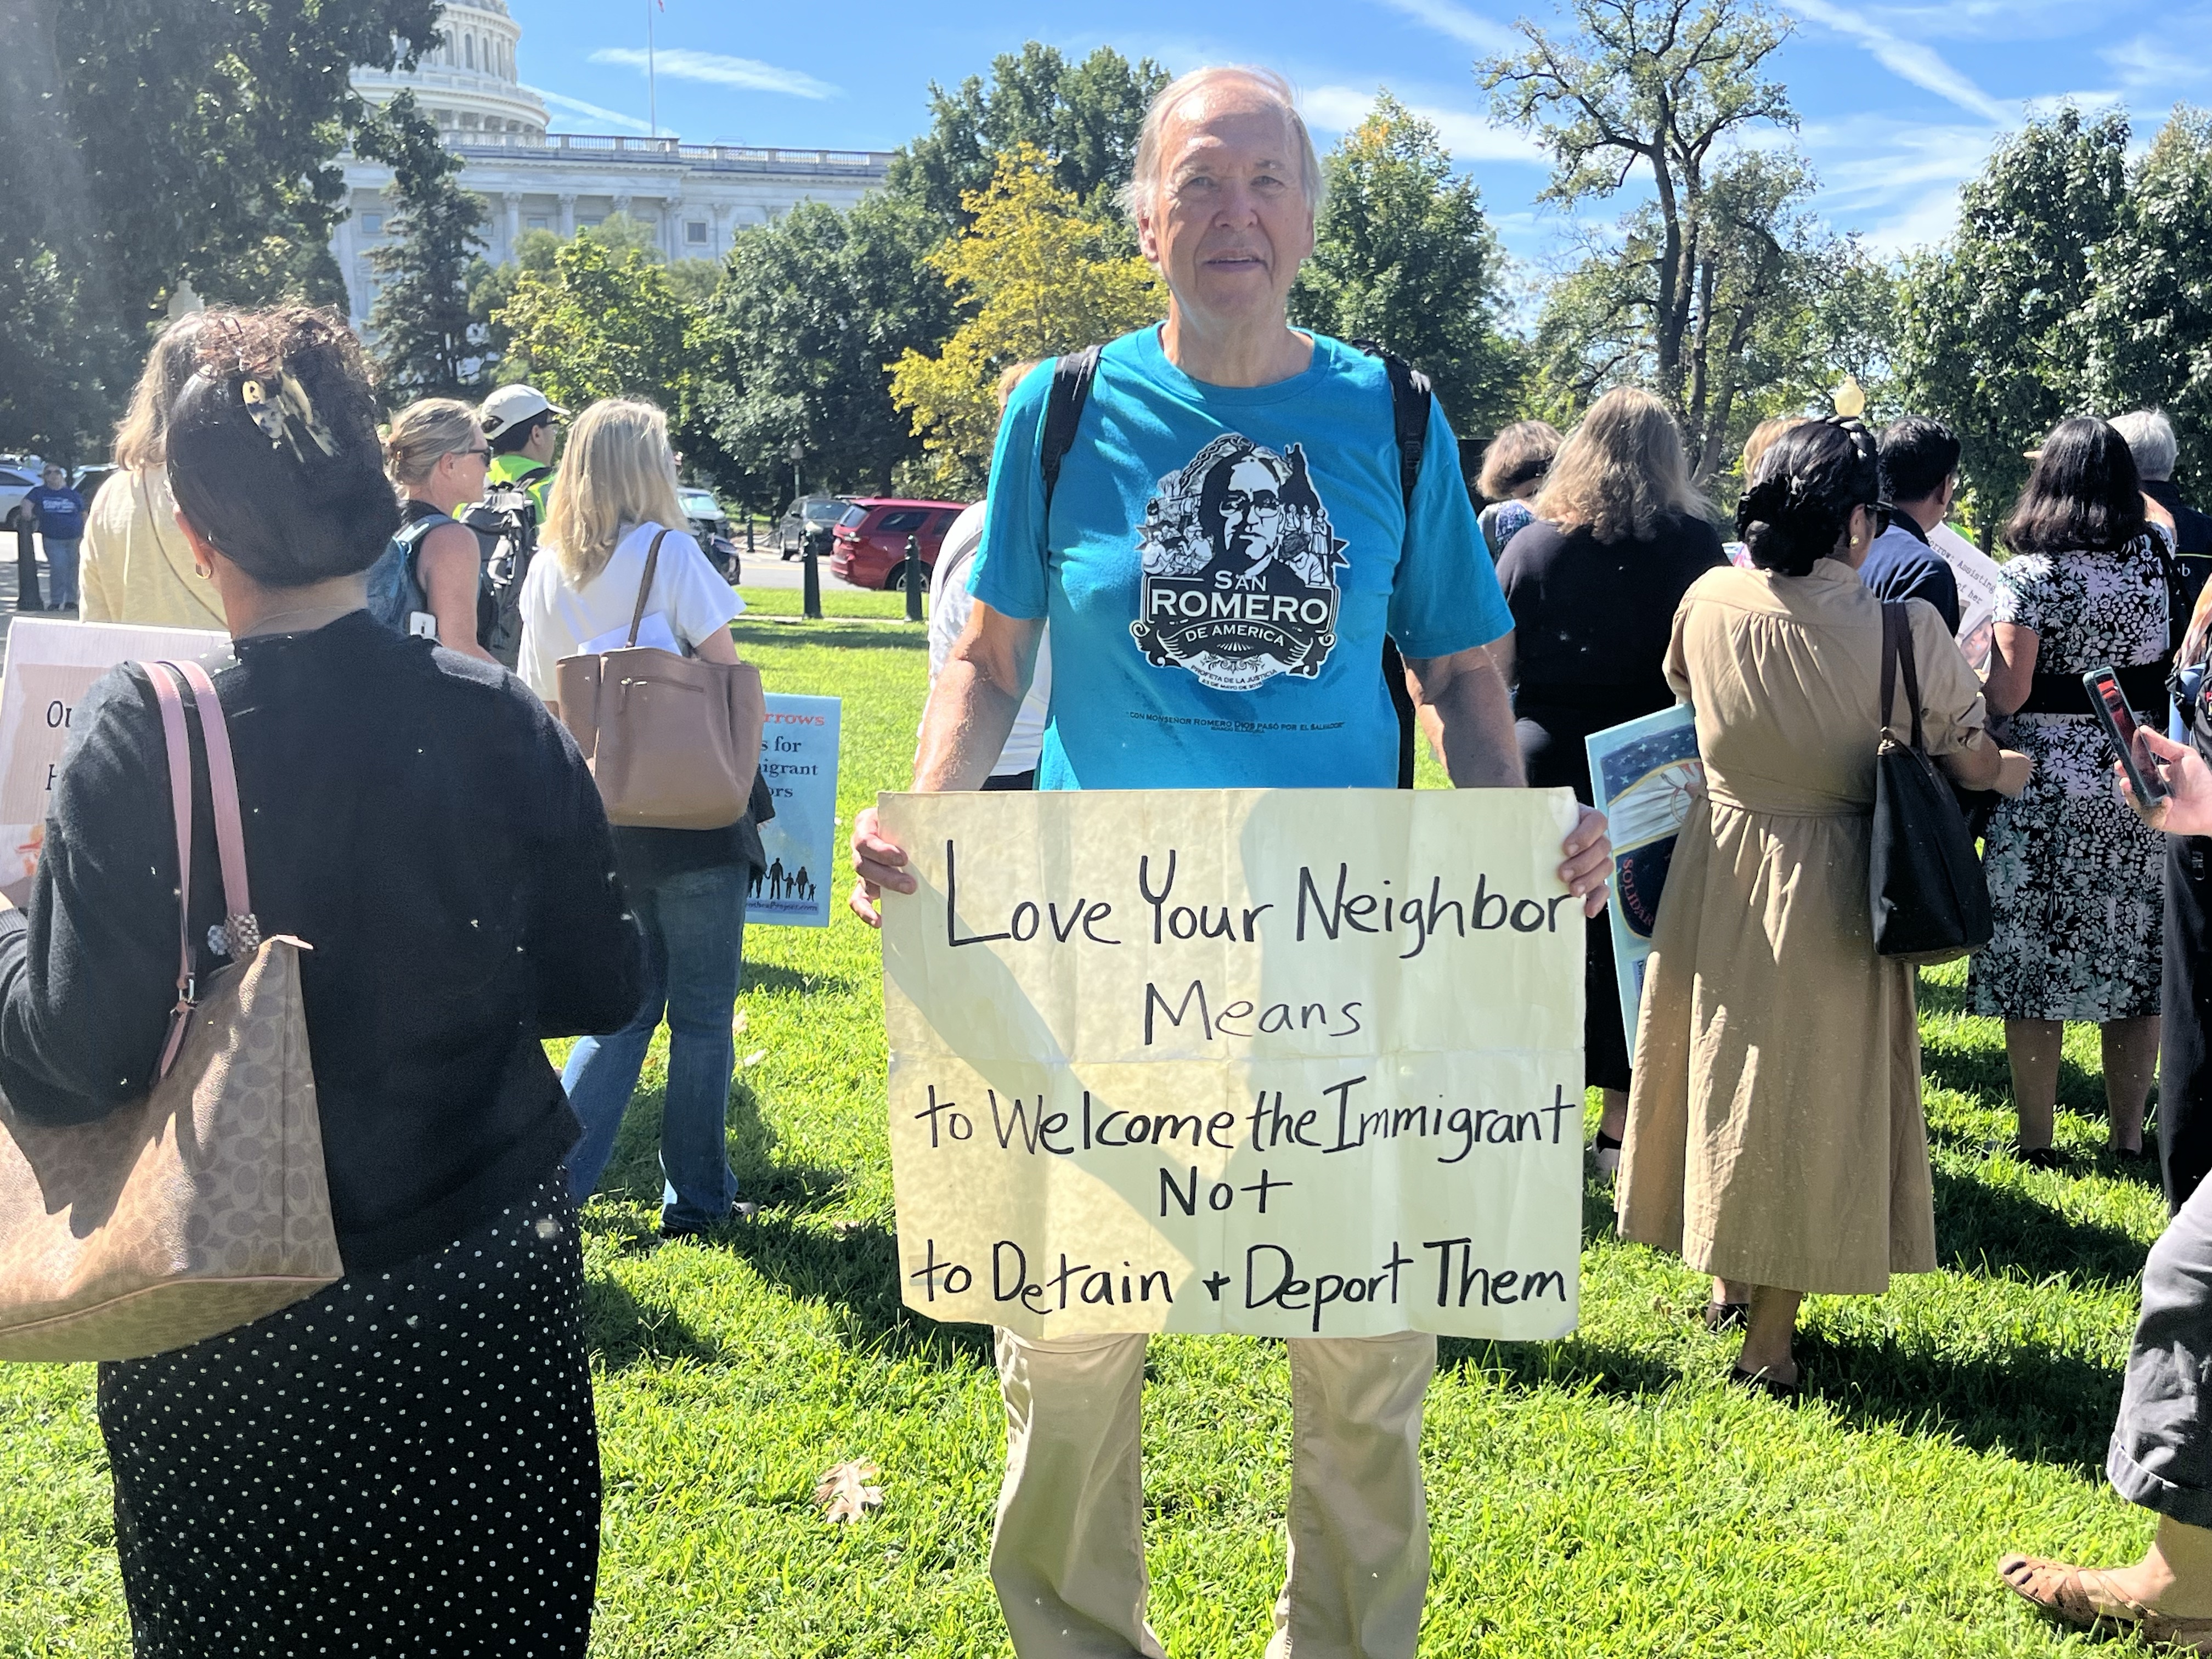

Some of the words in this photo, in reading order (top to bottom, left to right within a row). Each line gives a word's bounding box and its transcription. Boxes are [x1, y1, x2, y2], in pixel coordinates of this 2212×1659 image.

[1215, 570, 1266, 591] SAN
[1957, 560, 1996, 594] Assisting
[1151, 589, 1329, 625] ROMERO
[1968, 590, 1983, 604] her
[1185, 627, 1208, 642] DE
[1211, 624, 1284, 646] AMERICA
[1190, 665, 1222, 682] PROFETA
[1246, 669, 1278, 683] JUSTICIA
[1194, 718, 1232, 727] ROMERO
[775, 736, 802, 752] for
[947, 839, 1121, 947] Love
[1139, 849, 1274, 944] Your
[1296, 862, 1582, 960] Neighbor
[1144, 980, 1362, 1045] Means
[915, 1085, 973, 1148] to
[988, 1089, 1235, 1155] Welcome
[1246, 1091, 1322, 1152] the
[1322, 1075, 1576, 1164] Immigrant
[1159, 1166, 1293, 1217] Not
[910, 1238, 972, 1302] to
[993, 1240, 1173, 1316] Detain
[1245, 1241, 1414, 1332] Deport
[1423, 1237, 1567, 1307] Them
